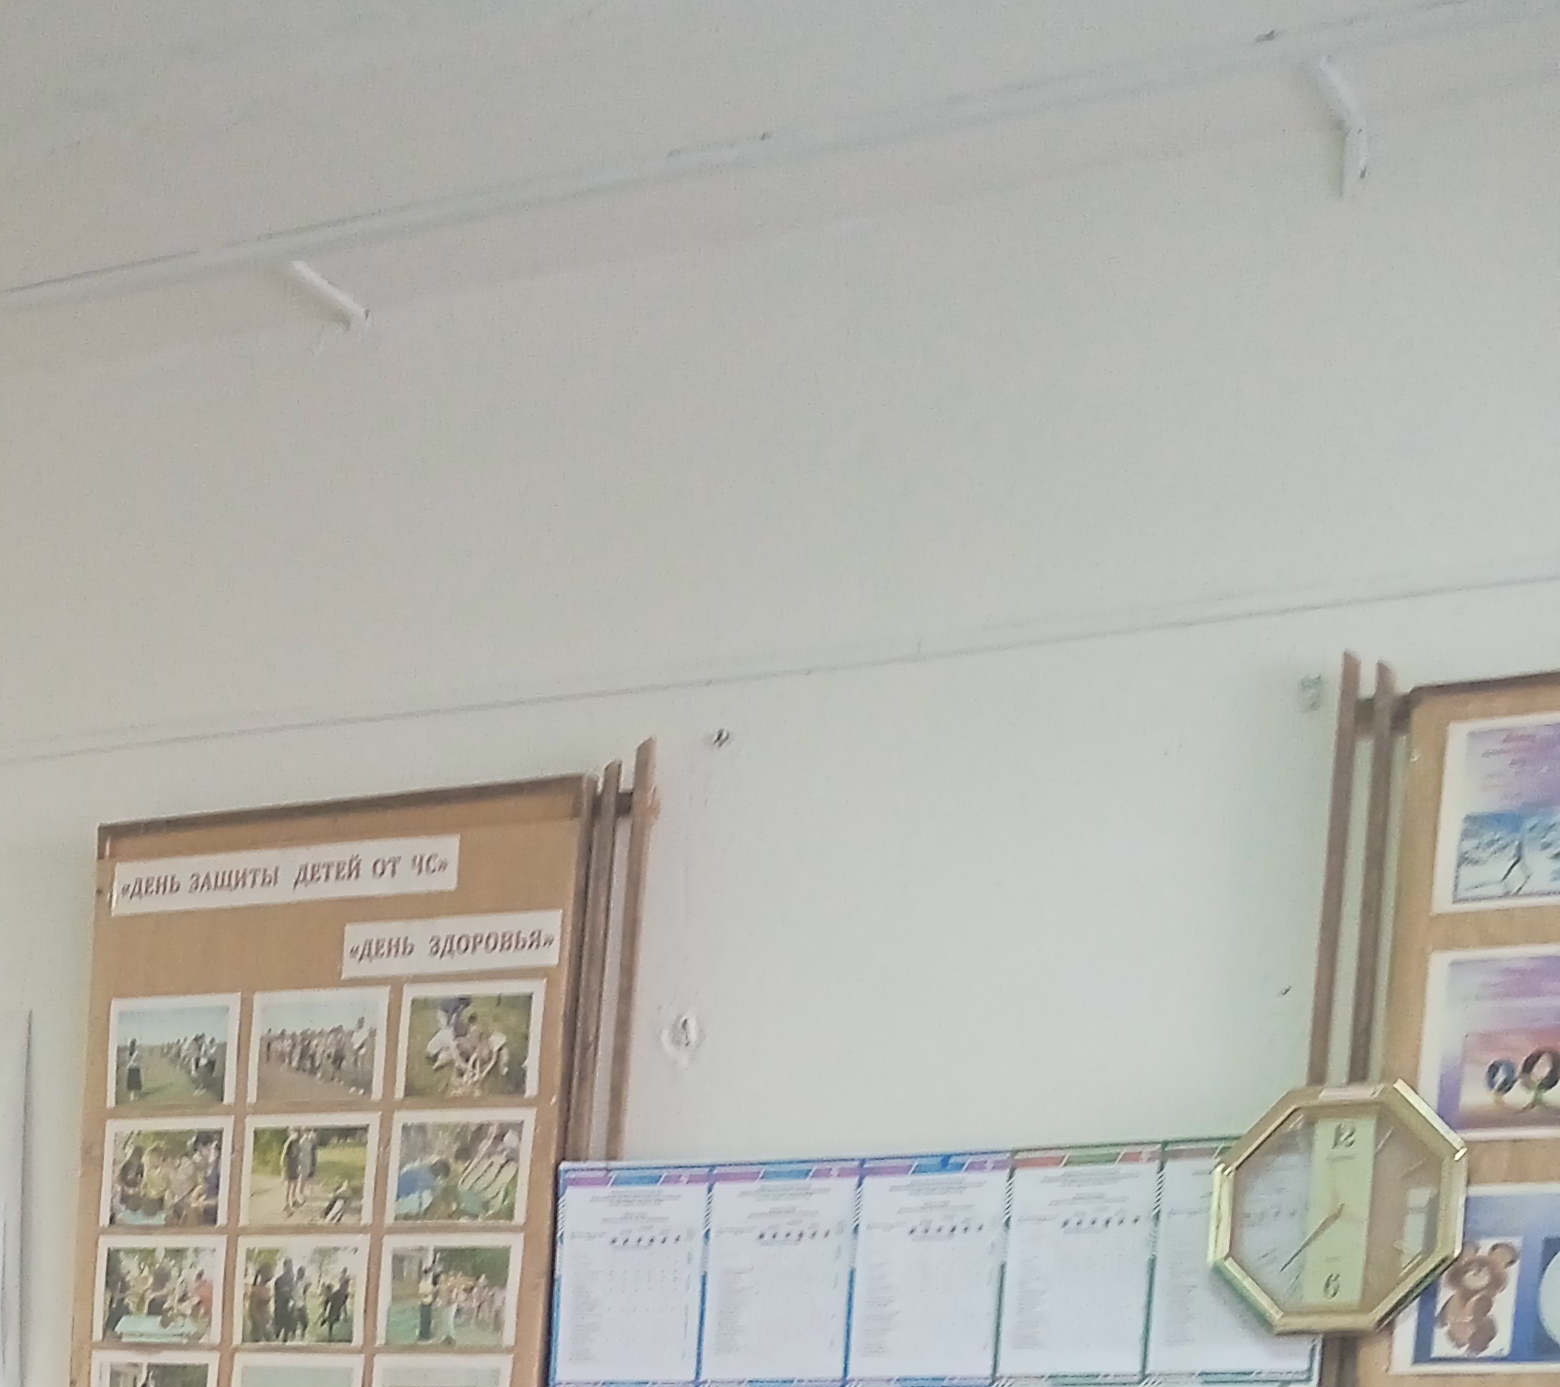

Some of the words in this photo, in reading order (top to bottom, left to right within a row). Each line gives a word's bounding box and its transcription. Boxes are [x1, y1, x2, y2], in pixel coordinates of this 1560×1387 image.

[121, 874, 181, 900] «ДЕНЬ
[188, 865, 278, 893] ЗАЩИТЫ
[293, 854, 361, 890] ДЕТЕЙ
[372, 855, 401, 879] ОТ
[412, 853, 448, 876] ЧС»
[349, 936, 414, 960] «ДЕНЬ
[428, 928, 555, 957] ЗДОРОВЬЯ»
[1332, 1122, 1356, 1150] 12
[1323, 1273, 1341, 1300] 6
